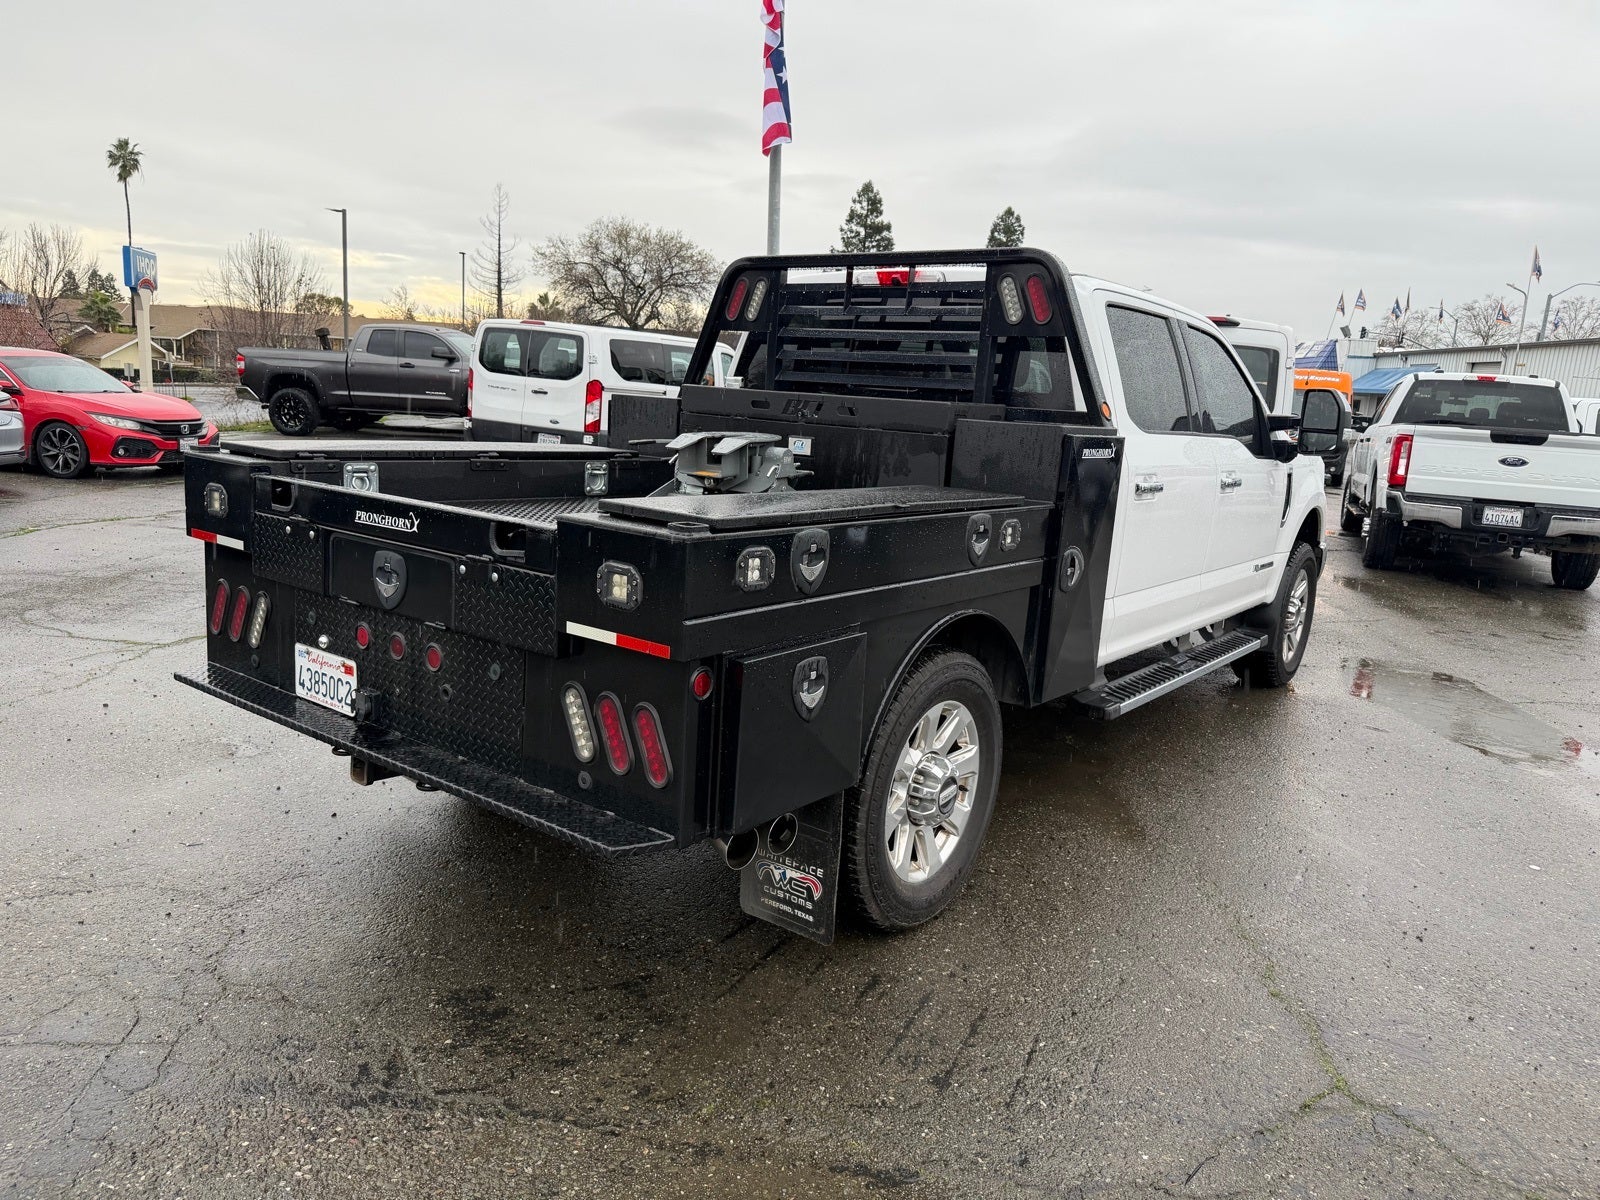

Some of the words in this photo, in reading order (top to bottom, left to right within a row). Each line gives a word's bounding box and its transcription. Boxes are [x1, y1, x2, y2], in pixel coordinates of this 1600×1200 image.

[136, 255, 156, 277] IHOP
[1082, 448, 1113, 457] PRONGHORN
[355, 510, 412, 530] PRONGHORN
[307, 651, 342, 671] California
[299, 664, 353, 707] 43850C2
[763, 885, 813, 910] CUSTOMS
[794, 909, 814, 922] TEXAS
